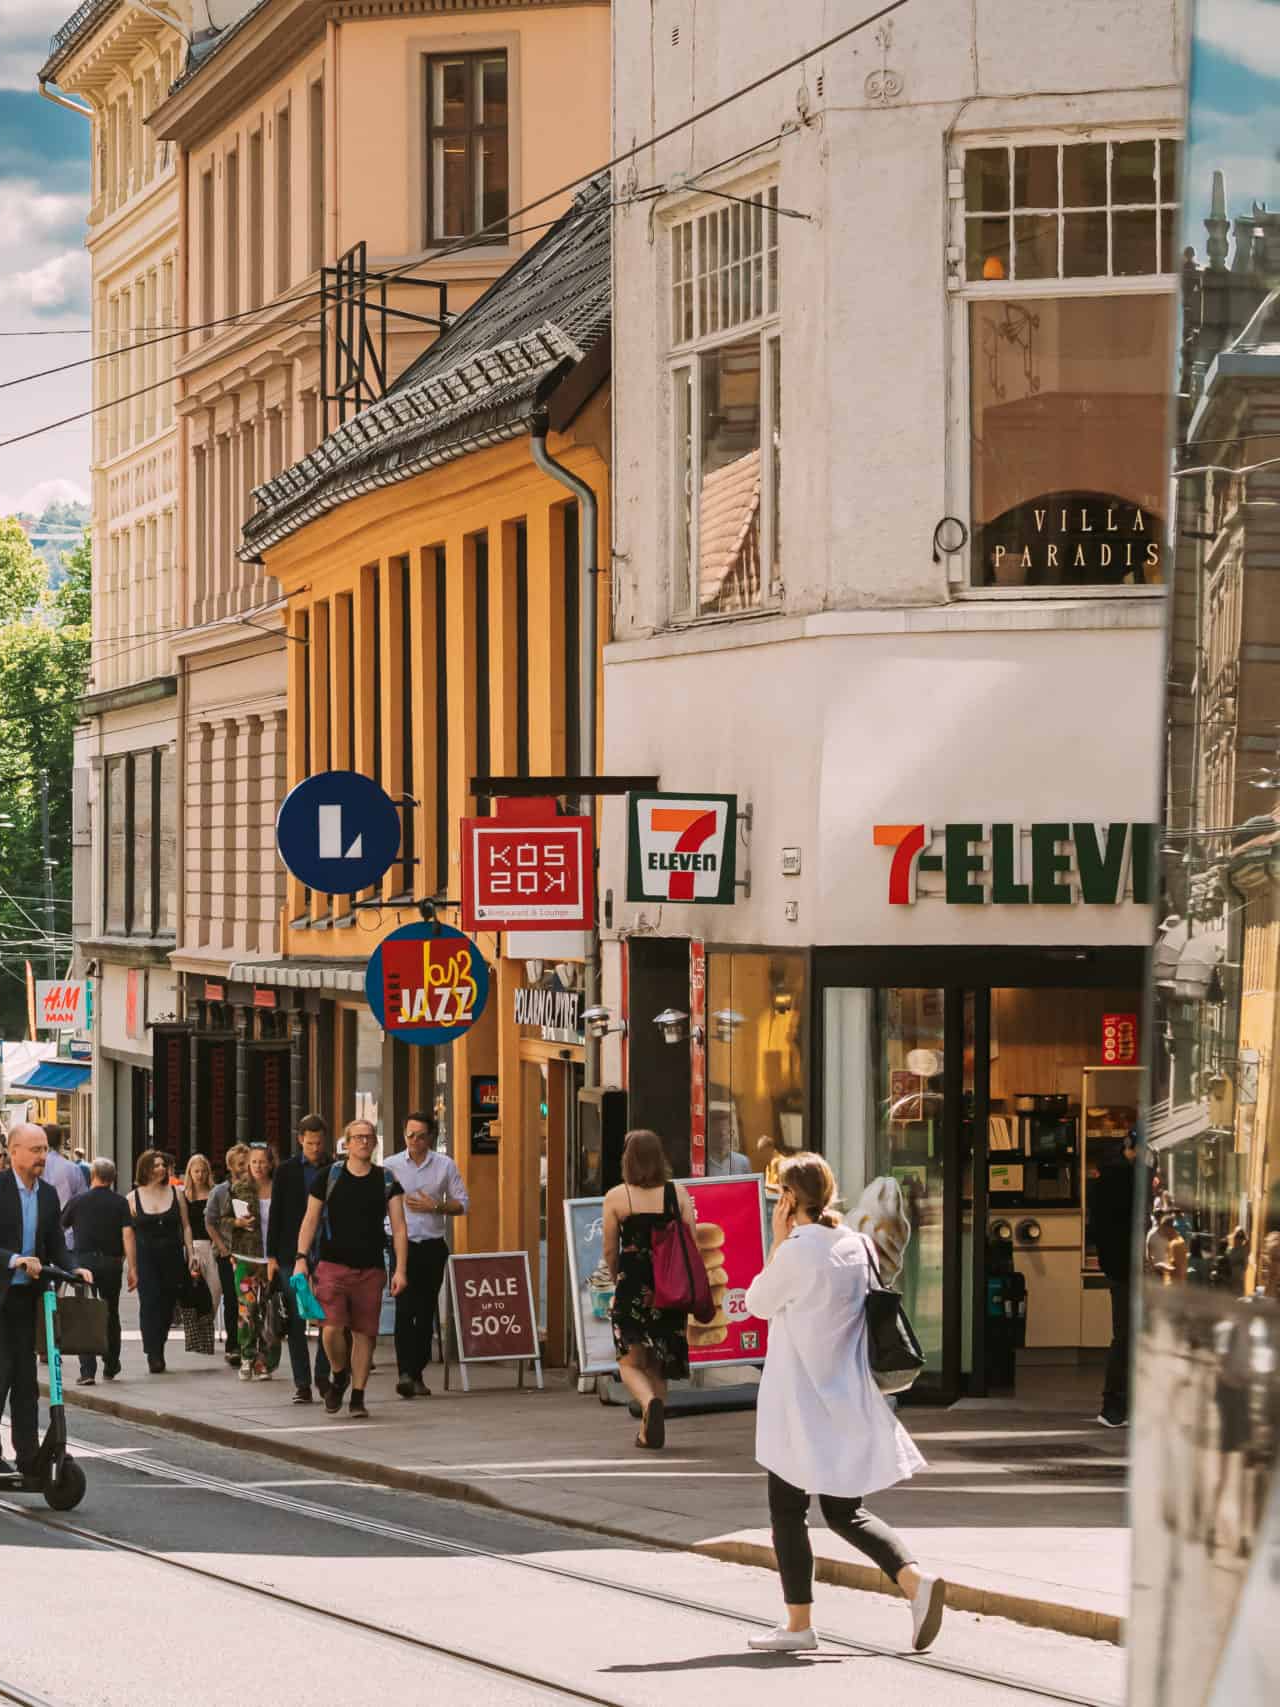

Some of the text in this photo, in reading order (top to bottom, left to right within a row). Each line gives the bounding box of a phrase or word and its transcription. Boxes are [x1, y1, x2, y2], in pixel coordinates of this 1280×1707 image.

[1033, 508, 1145, 532] VILLA
[650, 808, 717, 900] 7
[43, 985, 81, 1011] H&M
[397, 986, 473, 1023] JAZZ
[45, 1013, 74, 1023] MAN
[464, 1277, 519, 1298] SALE
[471, 1314, 521, 1336] 50%
